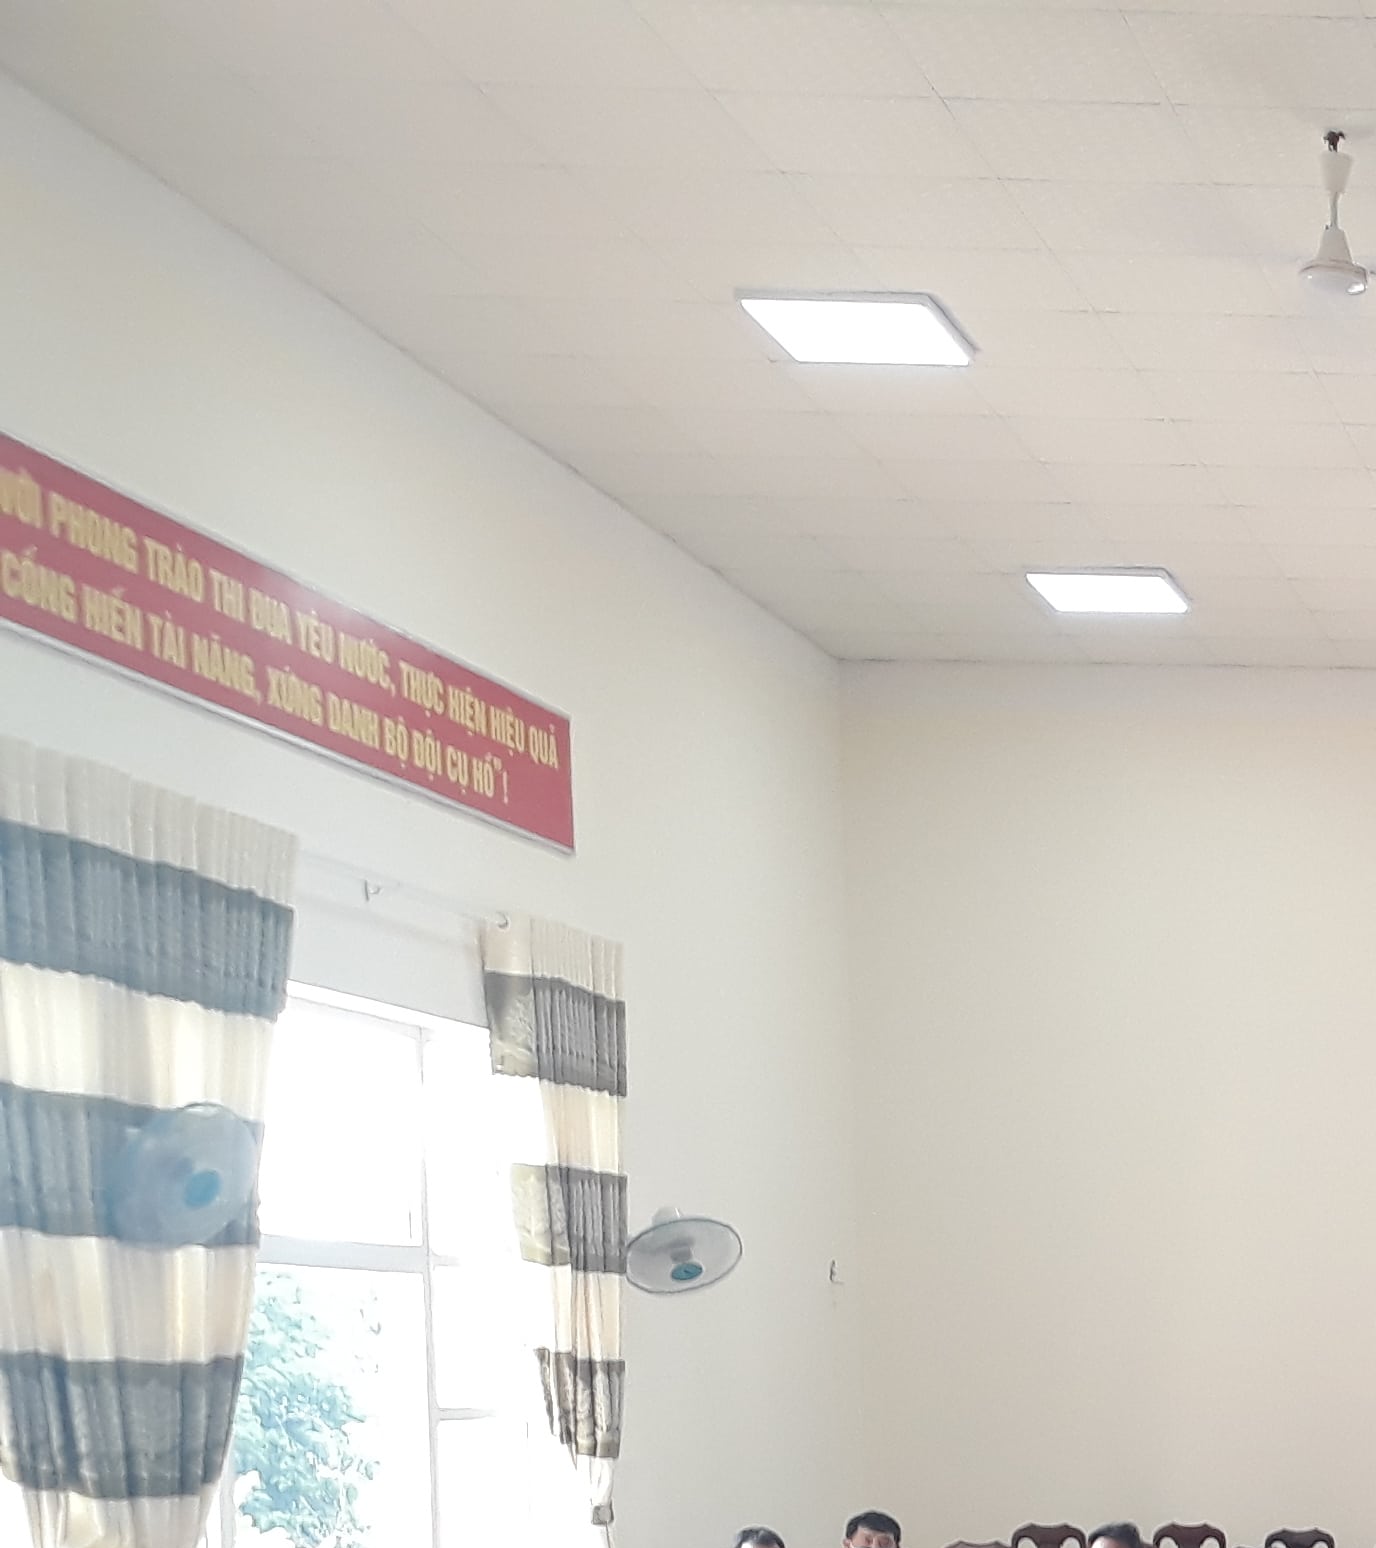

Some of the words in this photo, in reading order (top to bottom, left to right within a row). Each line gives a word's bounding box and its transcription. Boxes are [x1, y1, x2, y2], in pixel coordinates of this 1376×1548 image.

[1, 546, 76, 624] CỐNG
[82, 585, 144, 651] HIẾN
[147, 610, 187, 669] TÀI
[192, 634, 262, 704] NĂNG,
[267, 666, 323, 726] XỨNG
[327, 692, 380, 749] DANH
[383, 716, 408, 768] BỘ
[413, 729, 441, 781] ĐỘI
[447, 746, 468, 795] CỤ
[49, 490, 138, 574] PHONG
[144, 536, 204, 603] TRÀO
[209, 568, 245, 622] THI
[250, 588, 292, 645] ĐUA
[297, 610, 335, 663] YÊU
[339, 632, 396, 697] NƯỚC,
[399, 660, 445, 717] THỰC
[448, 686, 487, 736] HIỆN
[490, 706, 525, 756] HIỆU
[529, 725, 559, 770] QUẢ
